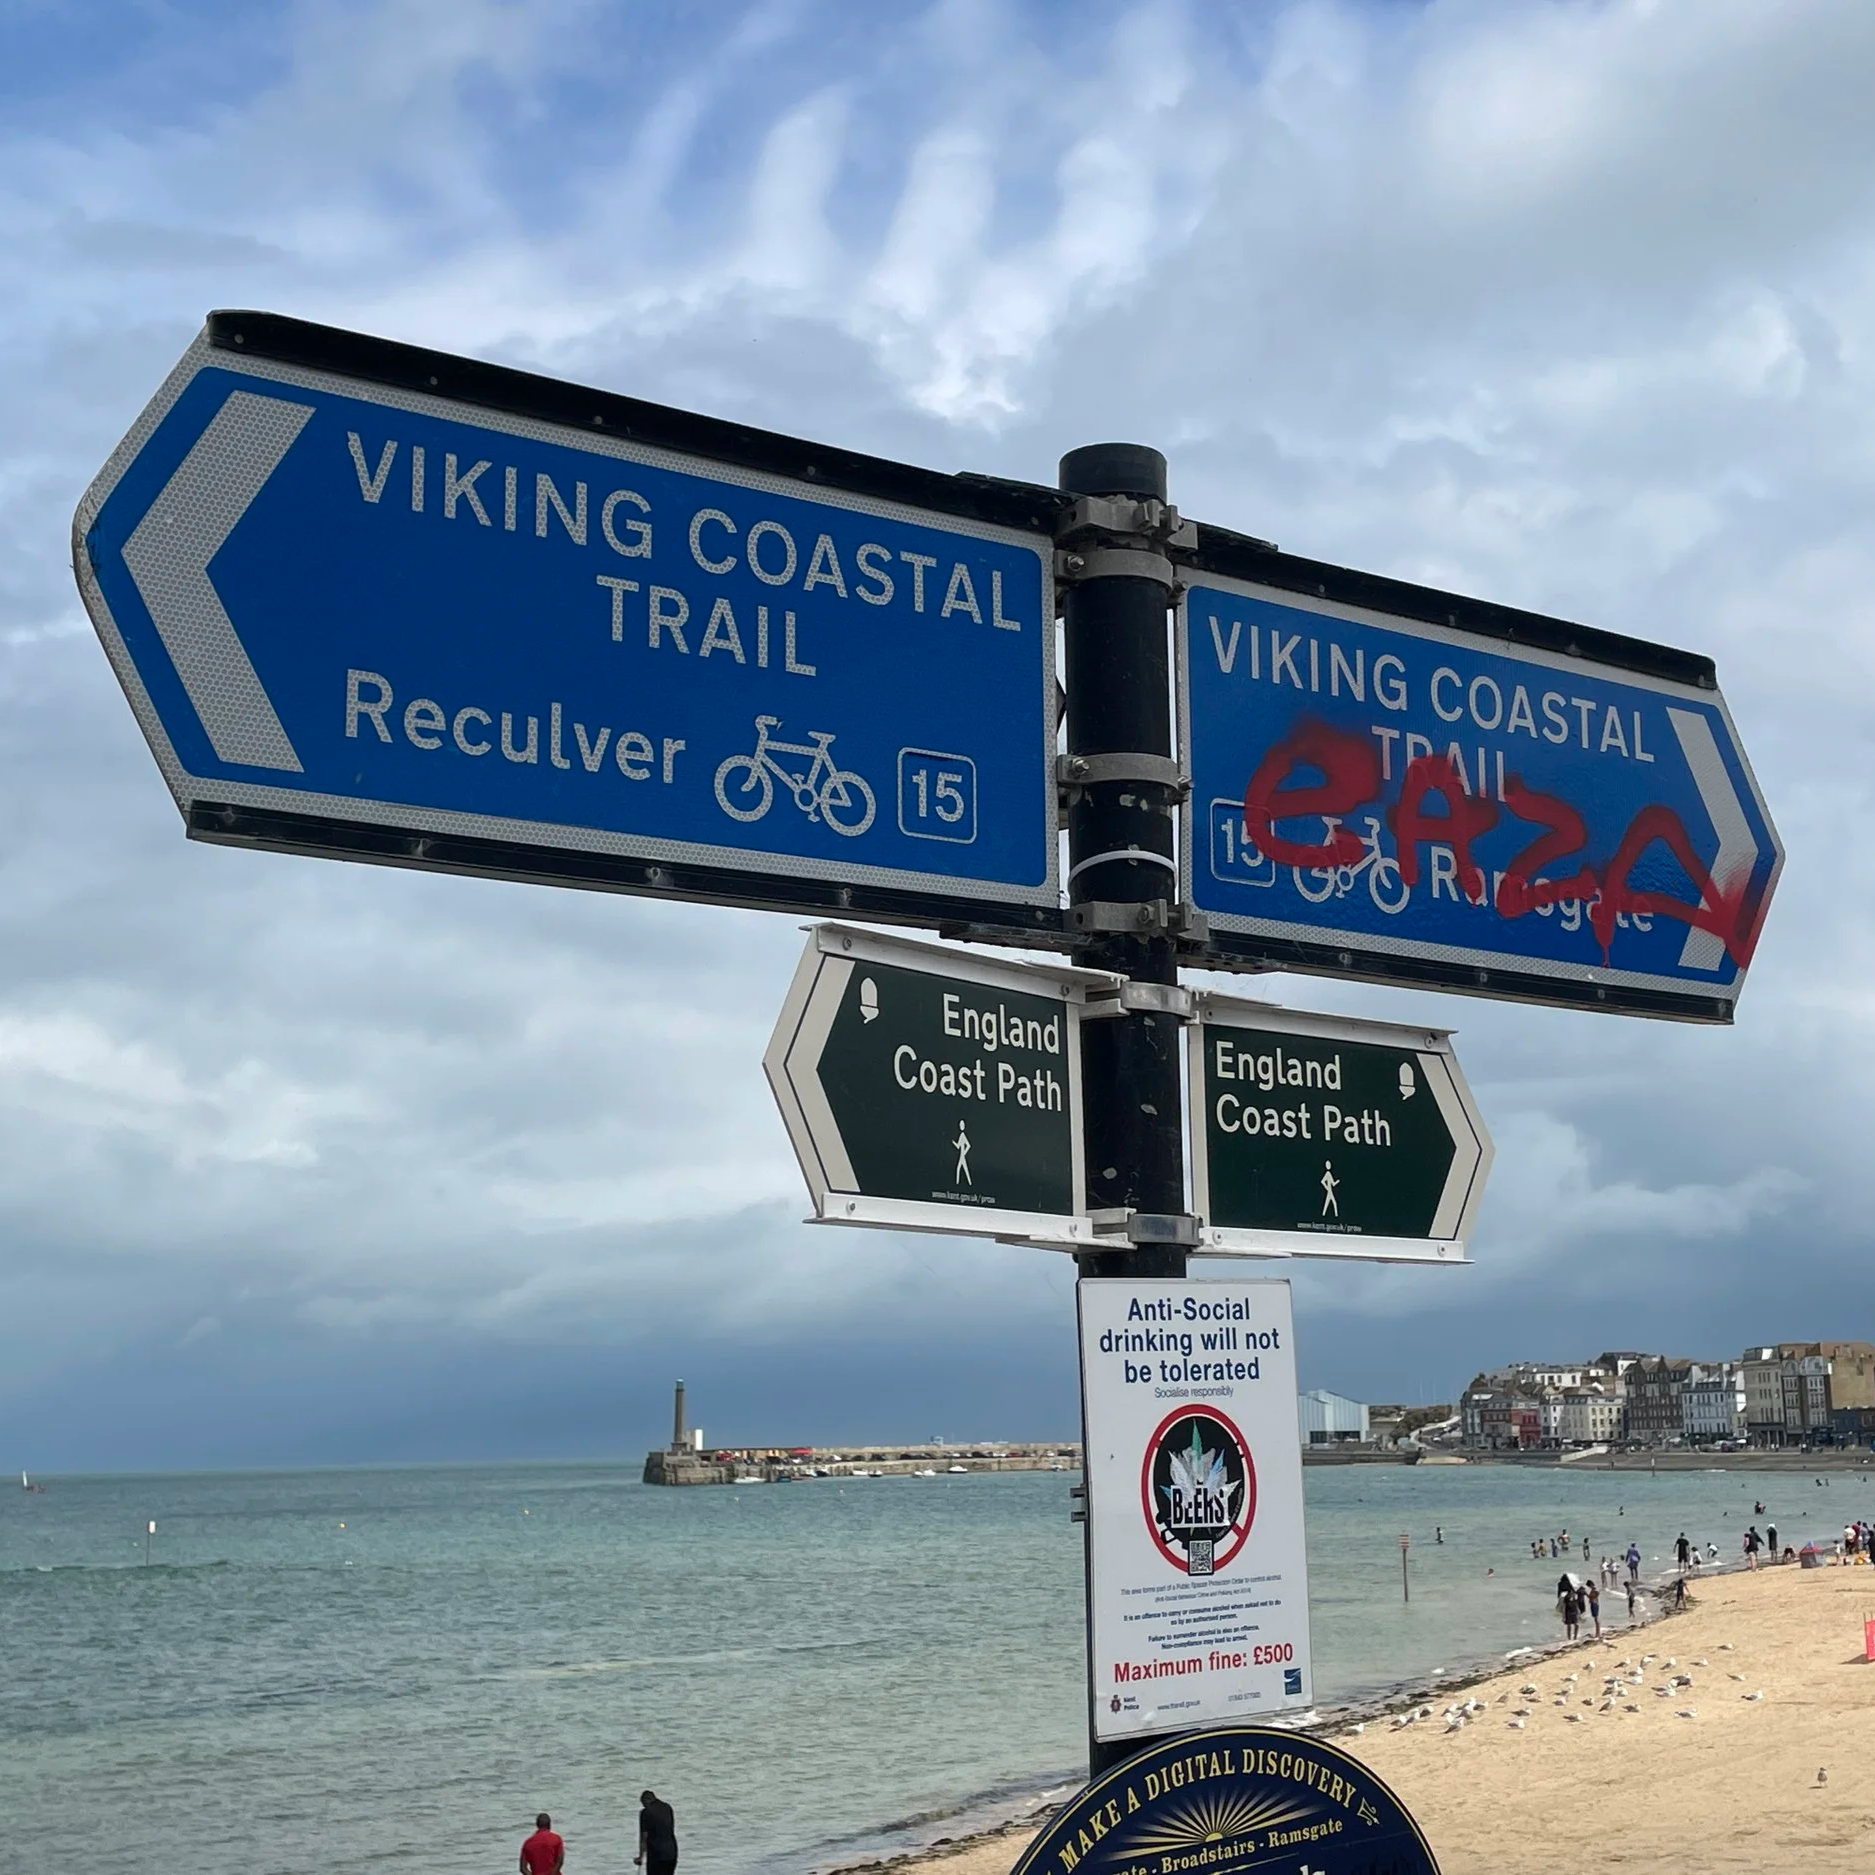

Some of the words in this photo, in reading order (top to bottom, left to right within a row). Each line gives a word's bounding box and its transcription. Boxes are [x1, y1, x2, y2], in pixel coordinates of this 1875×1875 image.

[348, 431, 653, 559] VIKING
[688, 508, 1021, 632] COASTAL
[596, 574, 817, 677] TRAIL
[1208, 615, 1408, 711] VIKING
[1430, 667, 1655, 763] COASTAL
[345, 668, 686, 784] Reculver
[911, 769, 965, 822] 15
[1220, 818, 1265, 868] 15
[943, 993, 1060, 1055] England
[894, 1044, 986, 1101] Coast
[997, 1062, 1062, 1112] Path
[1216, 1040, 1342, 1091] England
[1216, 1093, 1312, 1139] Coast
[1323, 1104, 1391, 1147] Path
[1127, 1297, 1250, 1321] Anti-Social
[1099, 1328, 1192, 1356] drinking
[1200, 1327, 1237, 1350] will
[1245, 1328, 1280, 1349] not
[1124, 1360, 1152, 1383] be
[1160, 1356, 1260, 1382] tolerated
[1154, 1386, 1190, 1398] Socialise
[1190, 1385, 1234, 1398] responsibly
[1114, 1657, 1203, 1684] Maximum
[1208, 1650, 1248, 1671] fine:
[1253, 1643, 1294, 1666] £500
[1058, 1798, 1122, 1874] MAKE
[1126, 1787, 1141, 1814] A
[1144, 1749, 1236, 1801] DIGITAL
[1242, 1748, 1357, 1808] DISCOVERY
[1161, 1840, 1255, 1874] Broadstairs
[1267, 1818, 1343, 1848] Ramsgate
